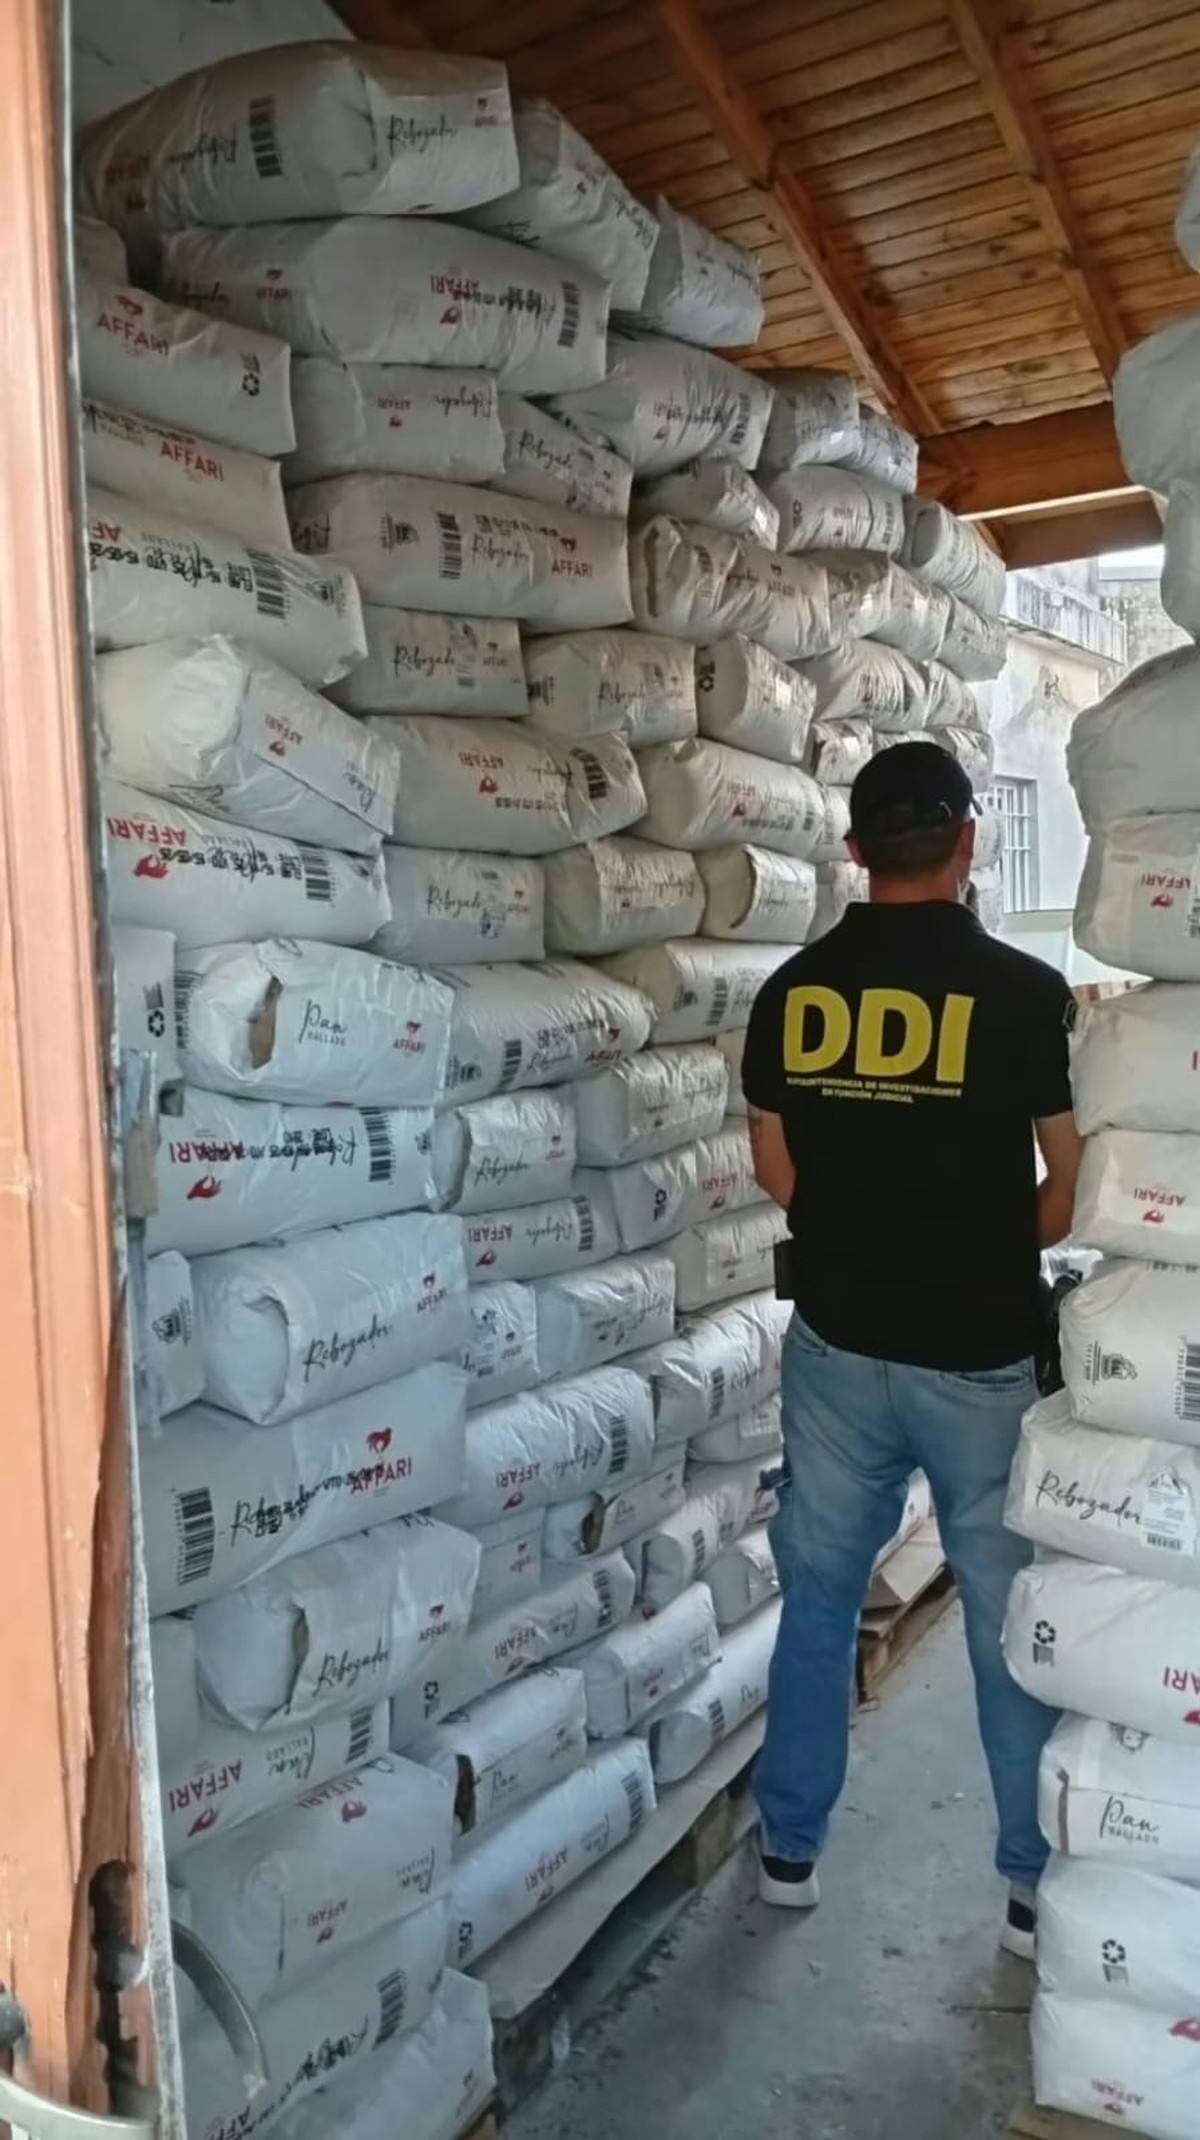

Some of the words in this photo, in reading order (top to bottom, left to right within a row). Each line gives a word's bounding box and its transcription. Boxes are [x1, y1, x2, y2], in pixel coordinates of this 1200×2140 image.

[96, 312, 169, 357] AFFARI
[160, 440, 224, 482] AFFARI
[552, 560, 594, 579] AFFARI
[107, 817, 187, 847] AFFARI
[298, 999, 348, 1044] Pan
[783, 985, 974, 1083] DDI
[1133, 1187, 1187, 1205] AFFARI
[468, 1224, 513, 1242] AFFARI
[416, 1288, 448, 1313] AFFARI
[302, 1313, 394, 1383] Rebozador
[350, 1456, 413, 1496] AFFARI
[495, 1463, 541, 1488] AFFARI
[1034, 1468, 1142, 1530] Rebozador
[494, 1626, 538, 1659] AFFARI
[168, 1760, 243, 1813] AFFARI
[1100, 1794, 1159, 1838] Pan
[524, 1847, 569, 1885] AFFARI
[306, 1898, 348, 1928] AFFARI
